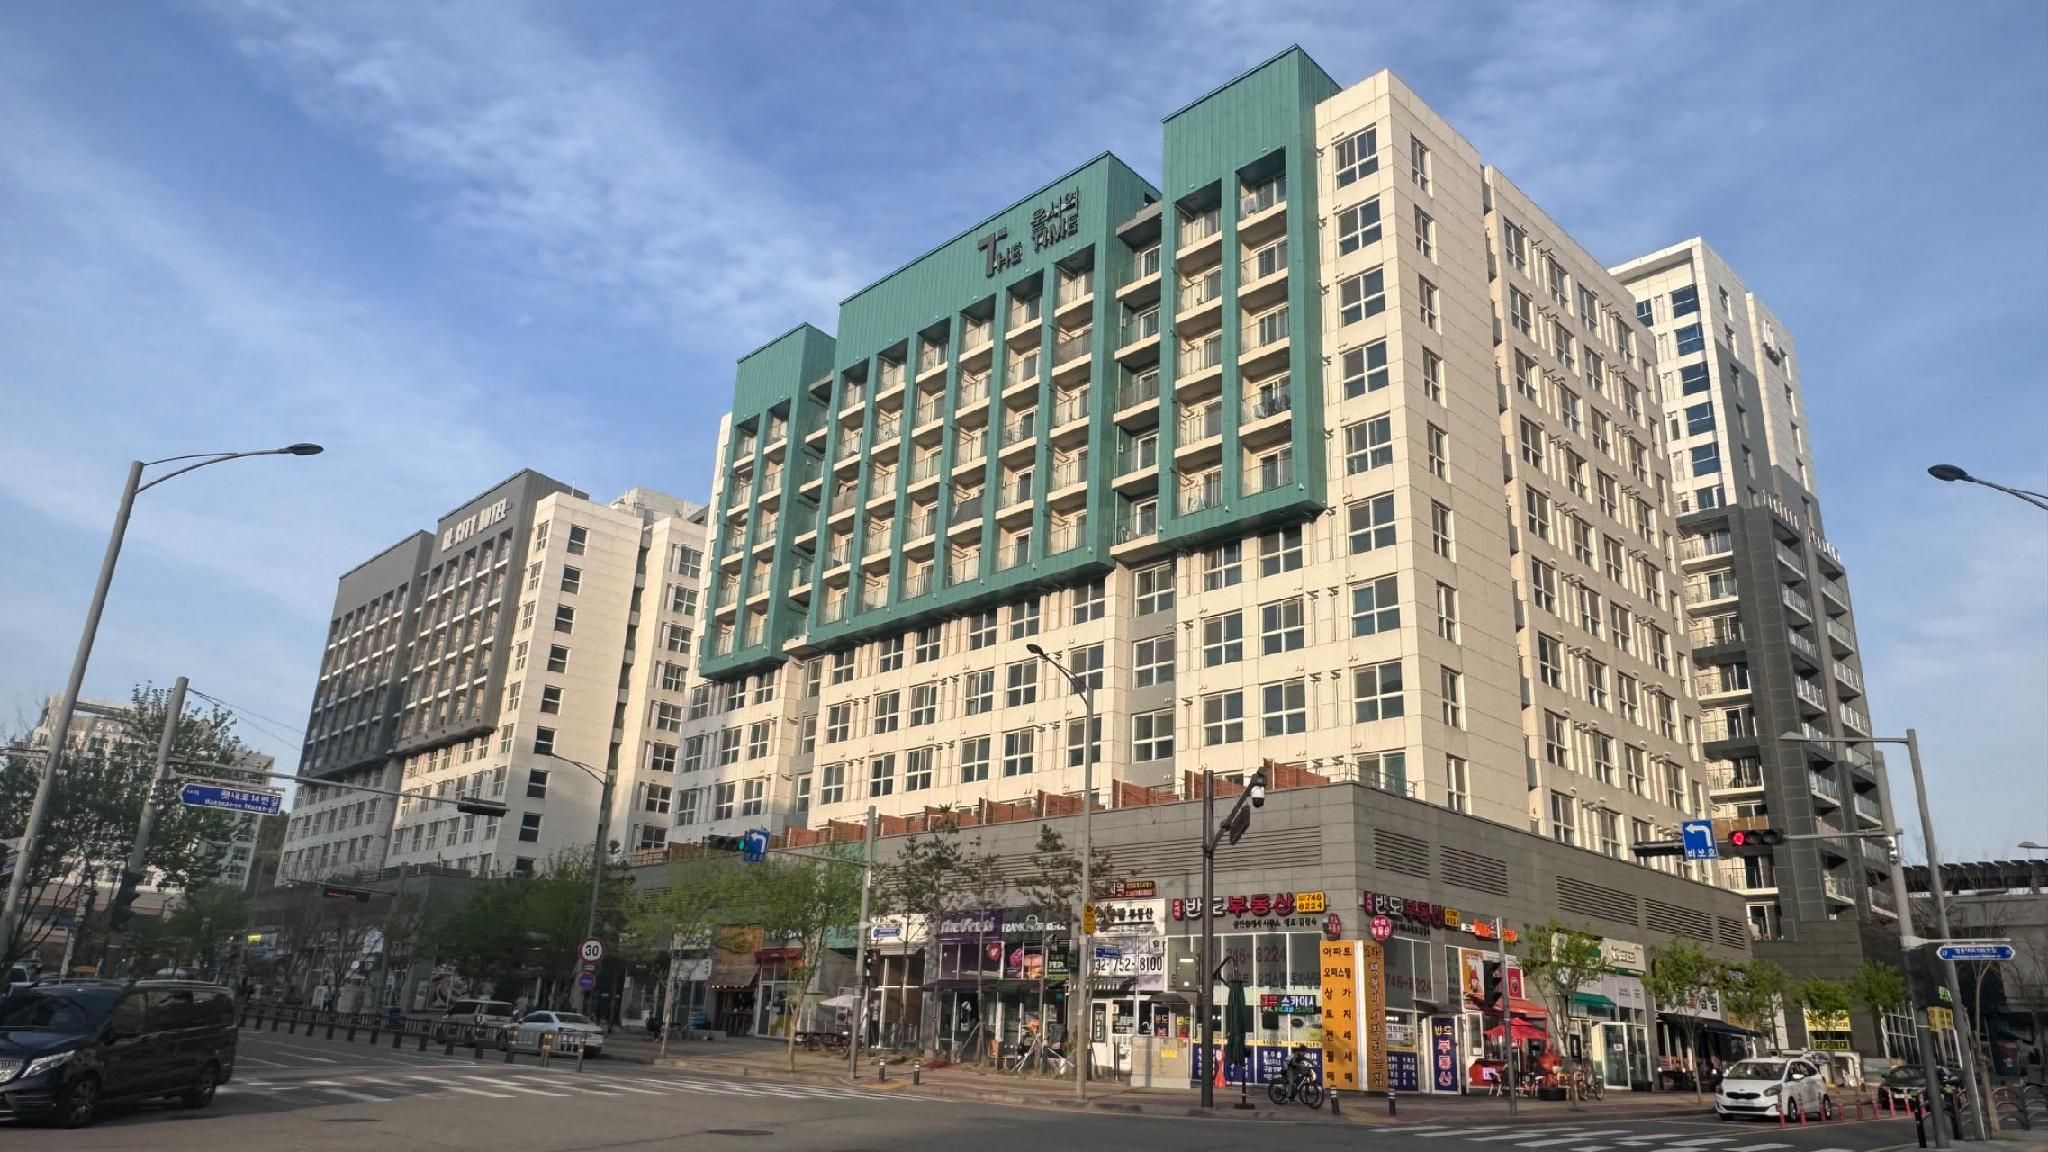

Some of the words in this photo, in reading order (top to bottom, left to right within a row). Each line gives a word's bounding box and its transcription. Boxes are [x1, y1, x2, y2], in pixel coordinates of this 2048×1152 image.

[977, 226, 1022, 278] THE
[1032, 212, 1079, 254] TIME
[1298, 902, 1323, 910] 8224
[585, 945, 600, 956] 30
[1323, 947, 1353, 956] 아파트
[1323, 967, 1351, 978] 오피스텔
